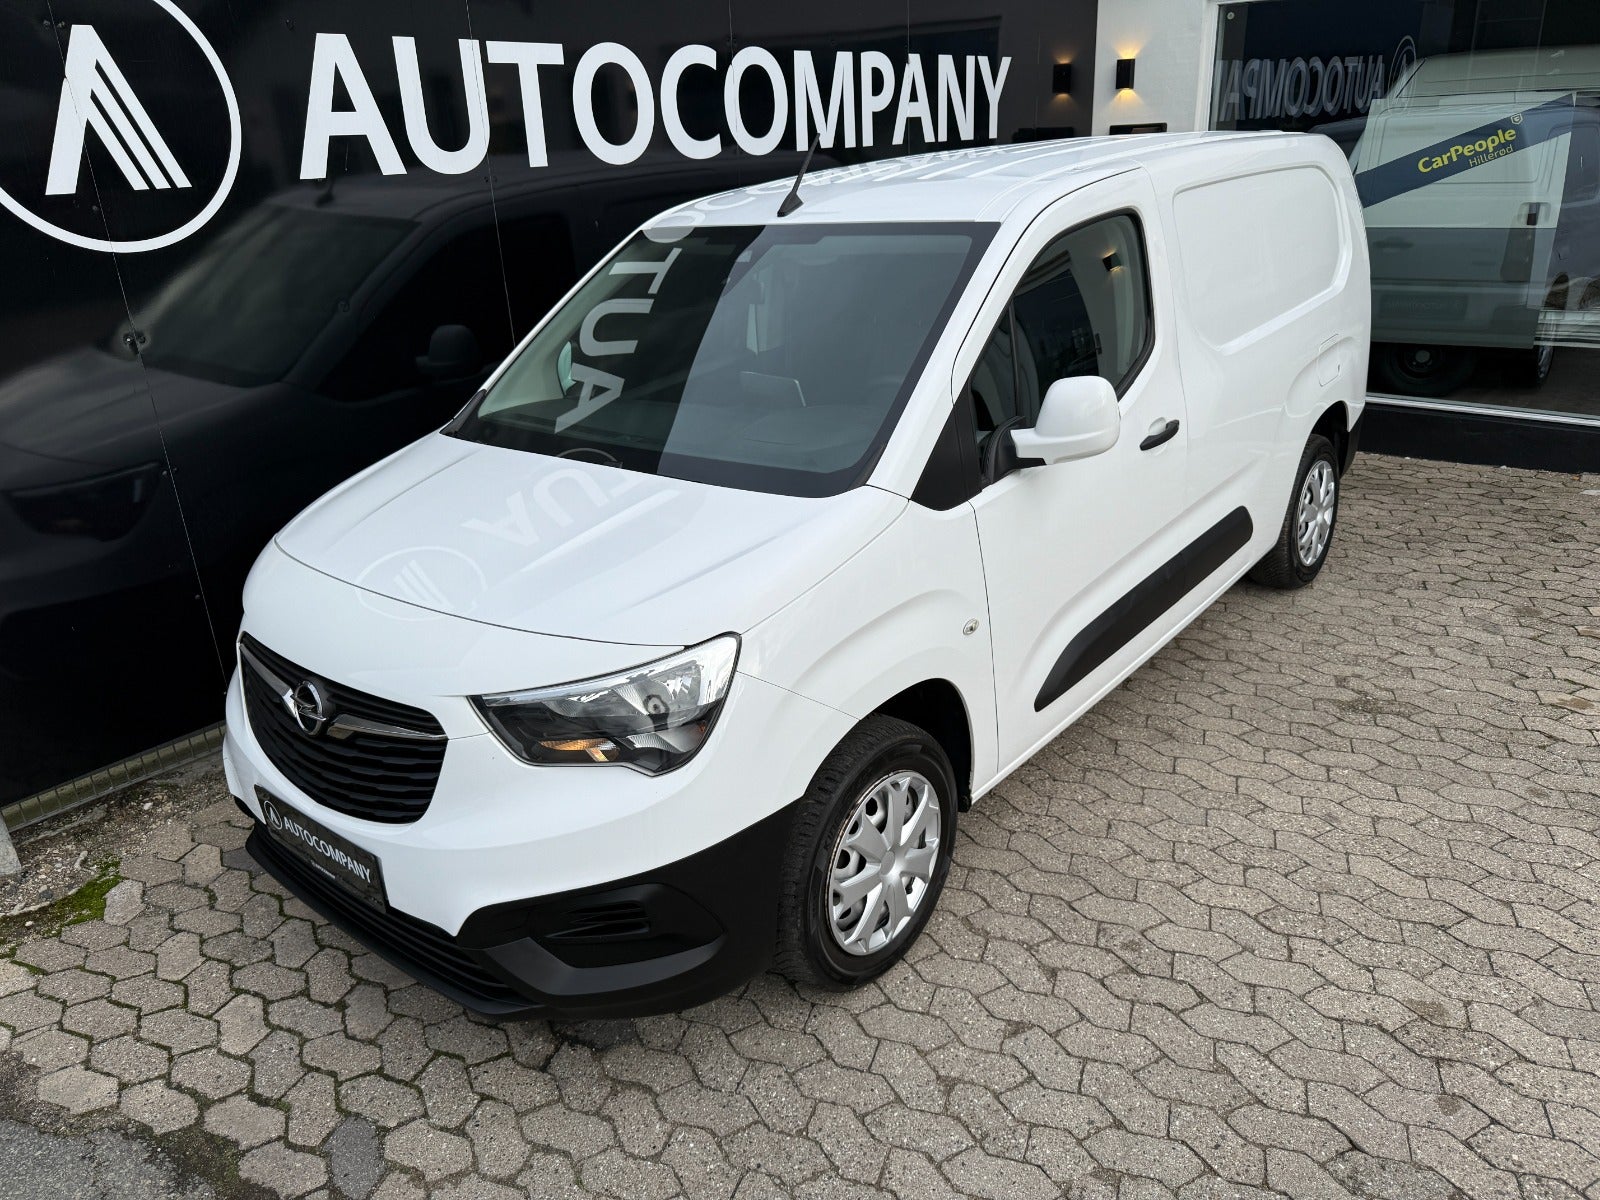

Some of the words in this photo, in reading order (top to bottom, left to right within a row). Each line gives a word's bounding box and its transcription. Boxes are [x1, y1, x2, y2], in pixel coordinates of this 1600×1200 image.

[300, 33, 1012, 180] AUTOCOMPANY
[1417, 128, 1517, 173] CarPeople
[1468, 144, 1514, 168] Hillerød
[283, 816, 372, 883] AUTOCOMPANY
